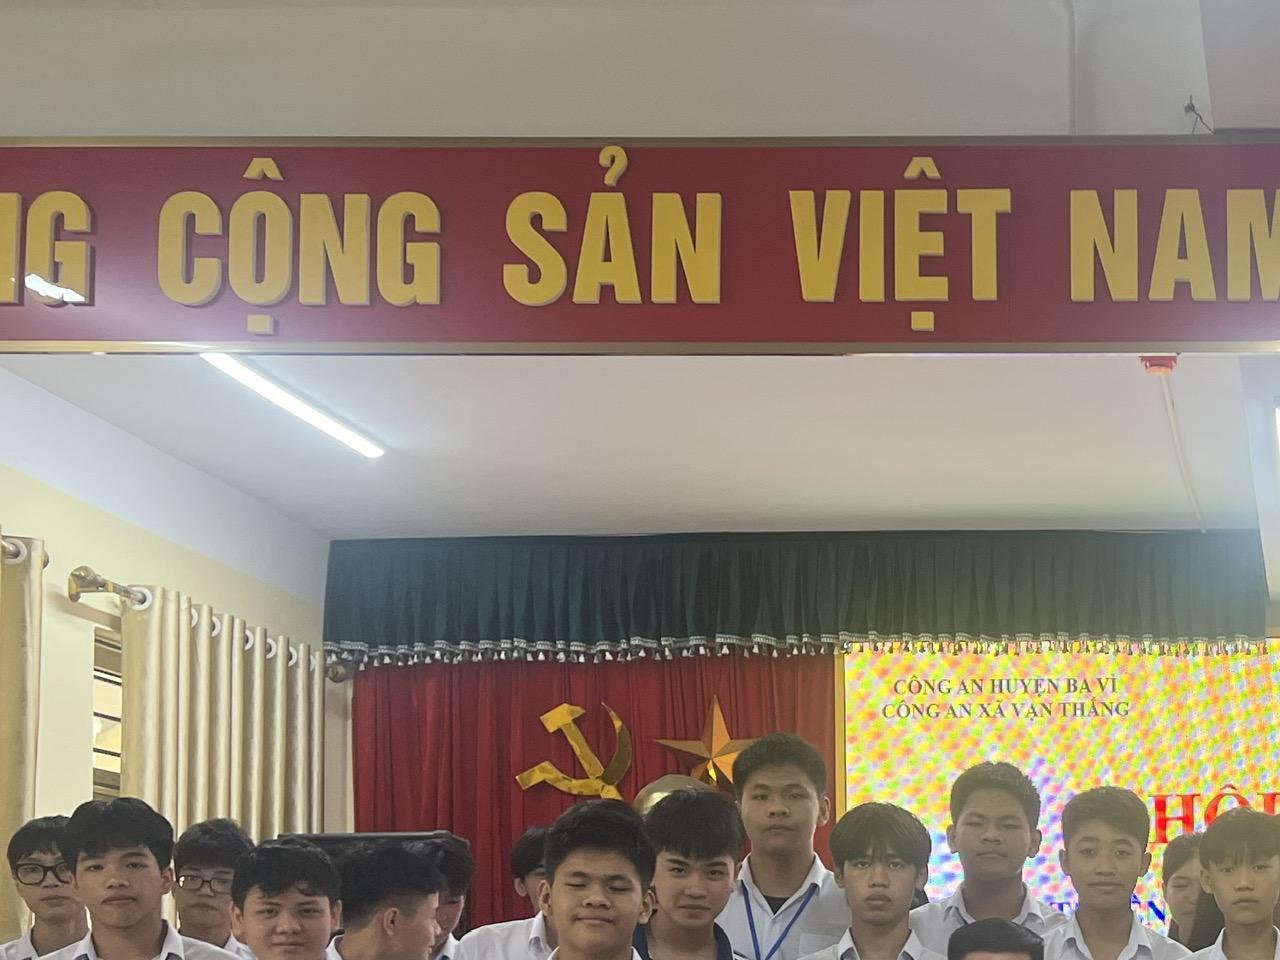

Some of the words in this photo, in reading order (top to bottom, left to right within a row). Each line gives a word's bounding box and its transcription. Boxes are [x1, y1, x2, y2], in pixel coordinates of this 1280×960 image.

[0, 190, 92, 305] G
[157, 157, 442, 336] CỘNG
[502, 145, 723, 307] SẢN
[788, 155, 1012, 332] VIỆT
[894, 674, 952, 695] CÔNG
[957, 678, 983, 695] AN
[989, 674, 1060, 697] HUYỆN
[1066, 677, 1092, 693] BA
[882, 699, 940, 719] CÔNG
[945, 703, 972, 718] AN
[979, 699, 1006, 718] XÃ
[1011, 702, 1052, 721] VẠN
